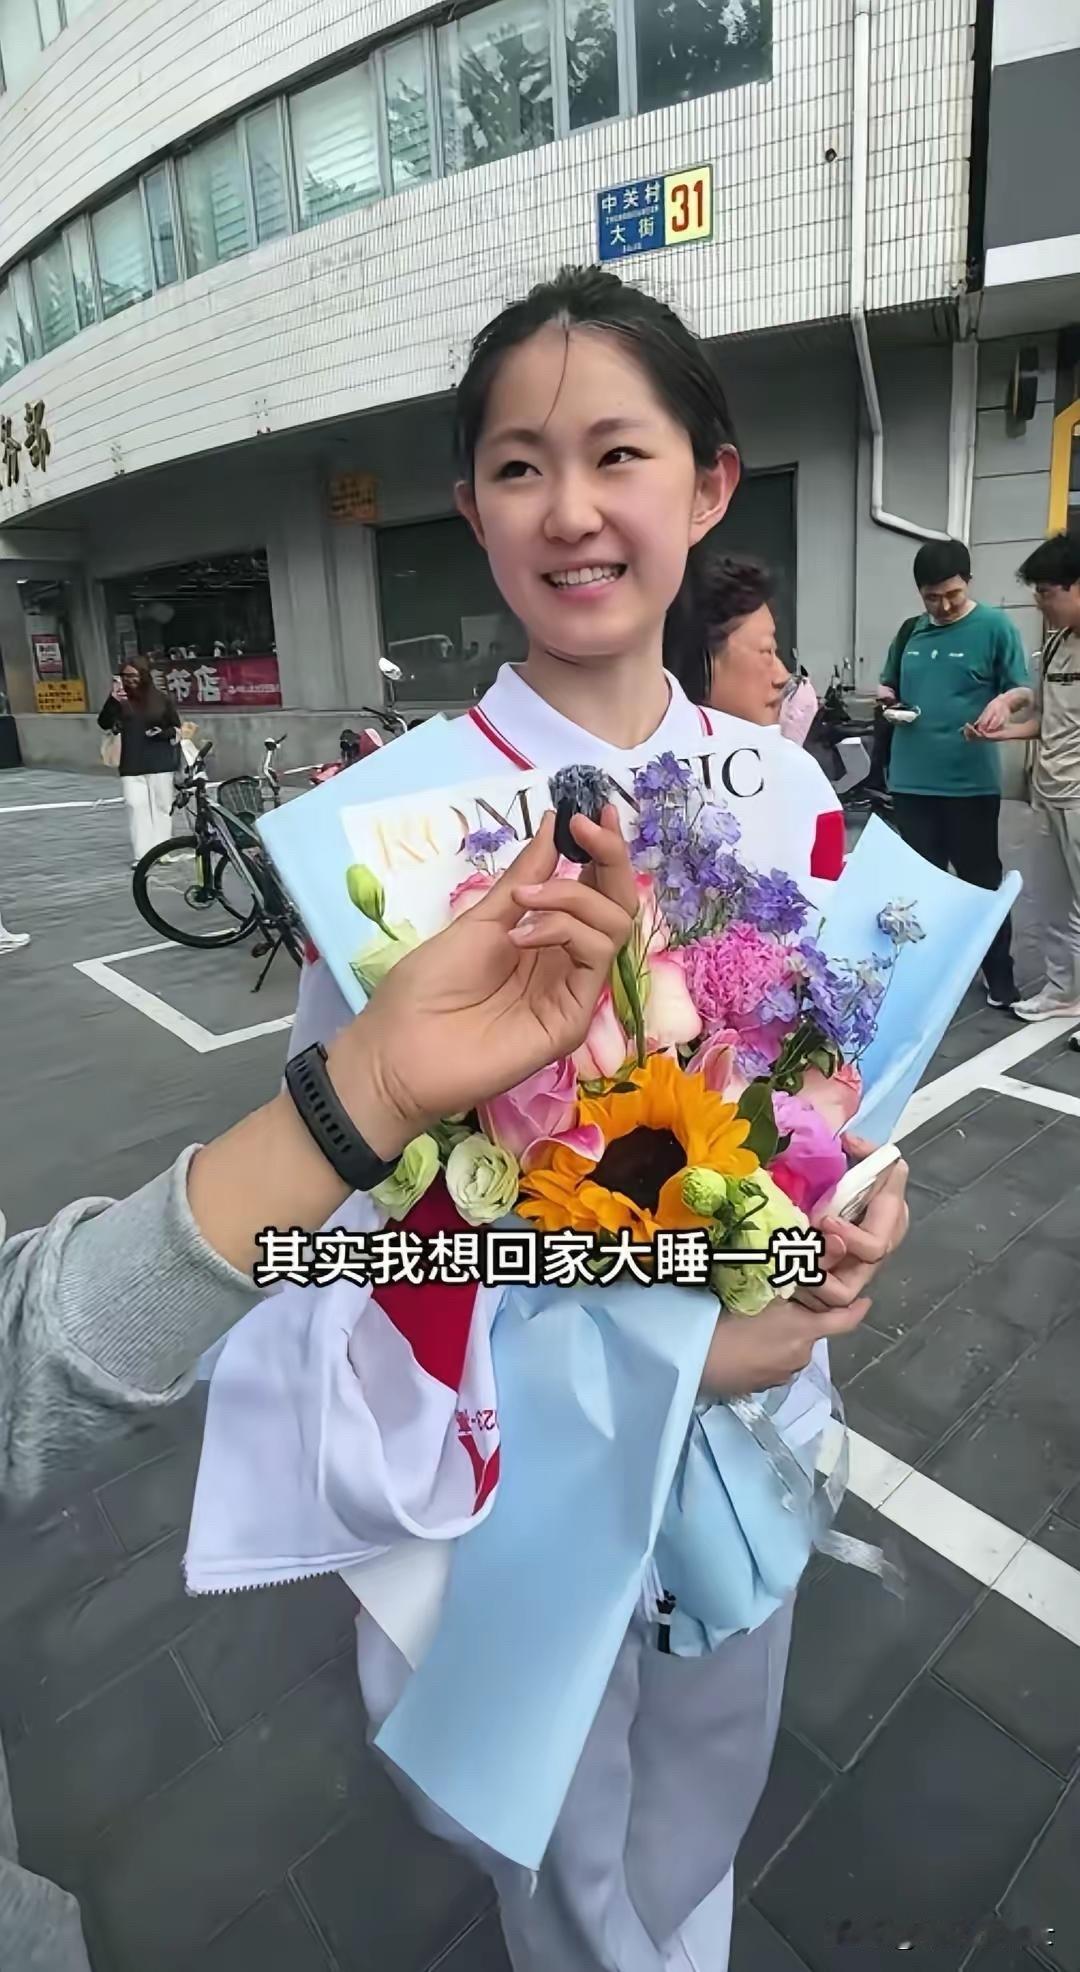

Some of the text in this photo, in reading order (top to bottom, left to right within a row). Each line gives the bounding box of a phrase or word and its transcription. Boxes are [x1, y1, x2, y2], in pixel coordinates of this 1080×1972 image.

[601, 181, 660, 214] 中关村
[671, 180, 703, 232] 31
[610, 216, 654, 246] 大街
